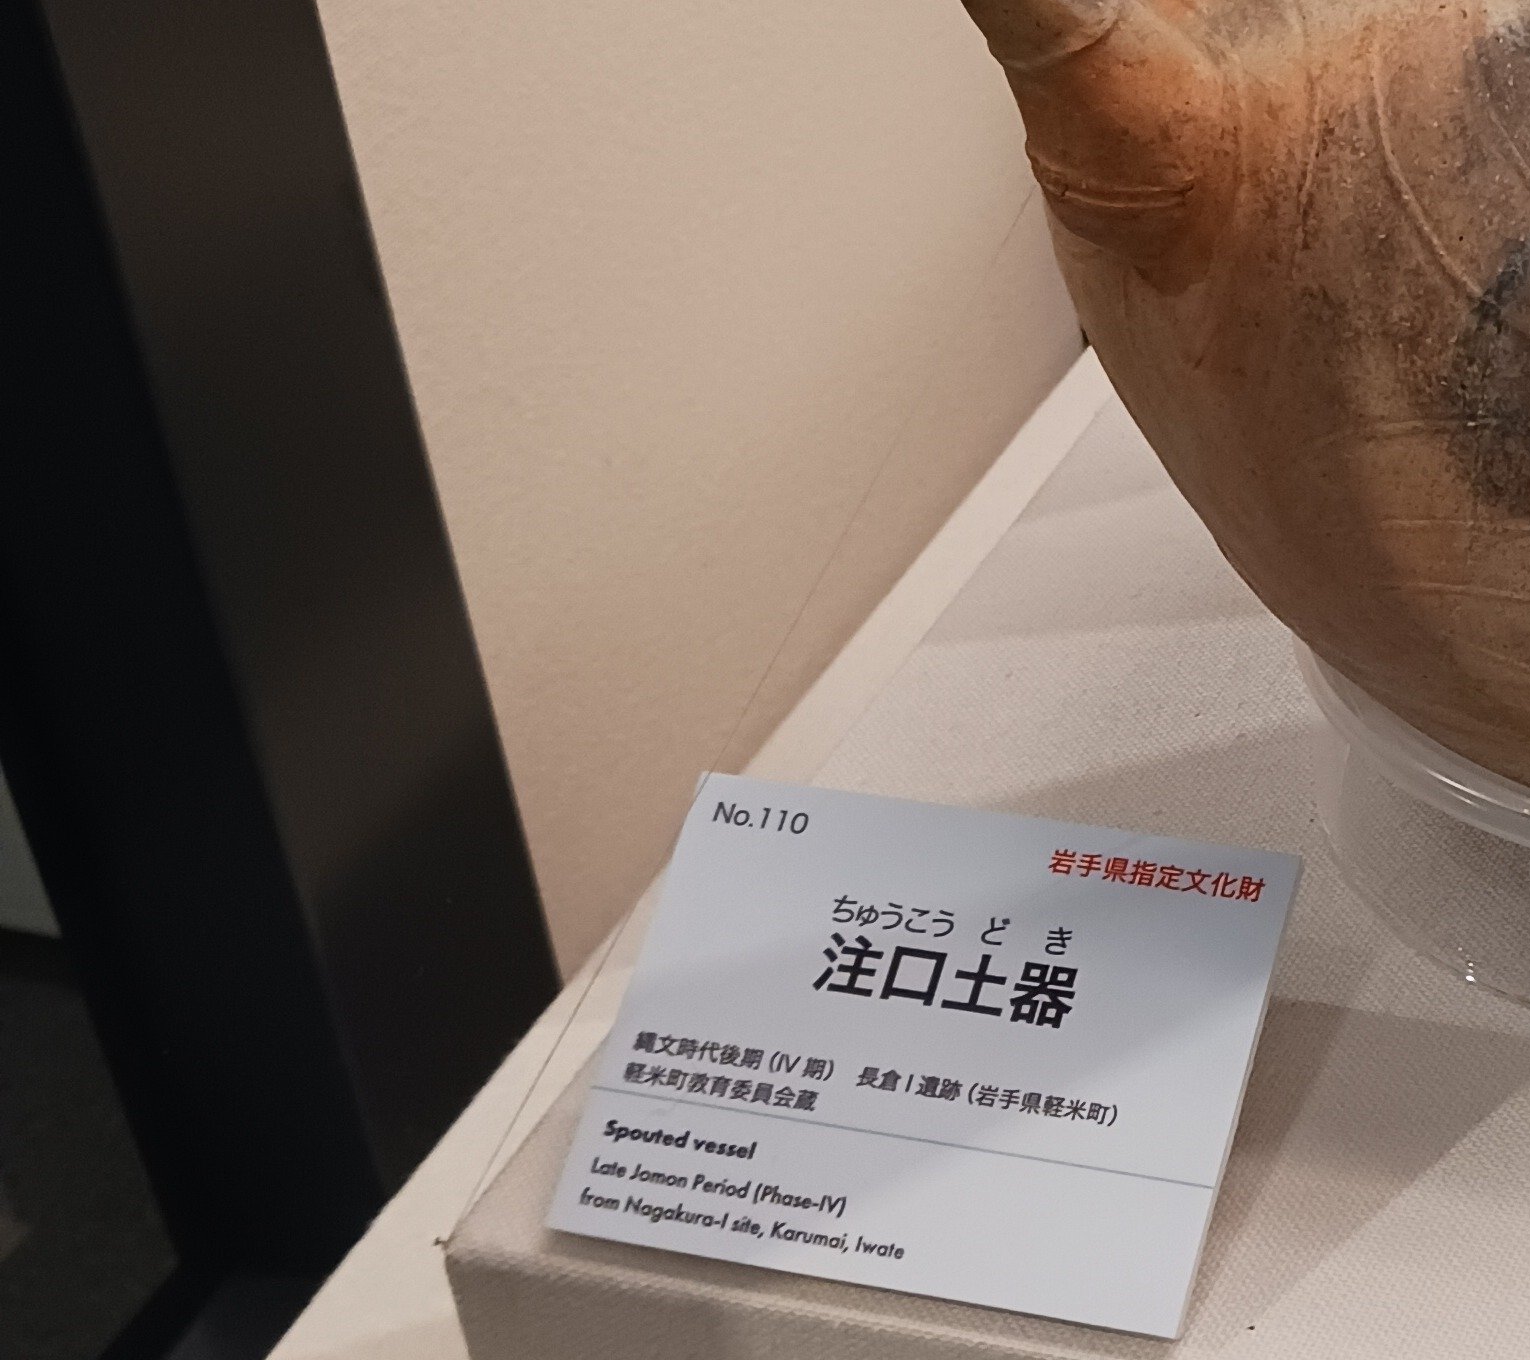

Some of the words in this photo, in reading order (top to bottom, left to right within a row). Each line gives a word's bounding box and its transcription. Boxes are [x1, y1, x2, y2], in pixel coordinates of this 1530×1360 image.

[712, 801, 810, 835] No.110
[1048, 848, 1266, 903] 岩手県指定文化財
[831, 894, 955, 938] ちゅうこう
[980, 916, 1010, 945] ど
[1044, 926, 1073, 955] き
[812, 931, 1079, 1029] 注口土器
[603, 1119, 691, 1149] Spouted
[693, 1138, 758, 1160] vessel
[590, 1156, 627, 1179] Late
[629, 1163, 688, 1189] Jomon
[692, 1174, 752, 1199] Period
[752, 1182, 848, 1218] (Phase-IV)
[579, 1186, 620, 1211] from
[623, 1195, 730, 1230] Nagakura-I
[731, 1215, 763, 1239] site,
[769, 1220, 849, 1255] Karumai,
[854, 1235, 906, 1260] Iwate
